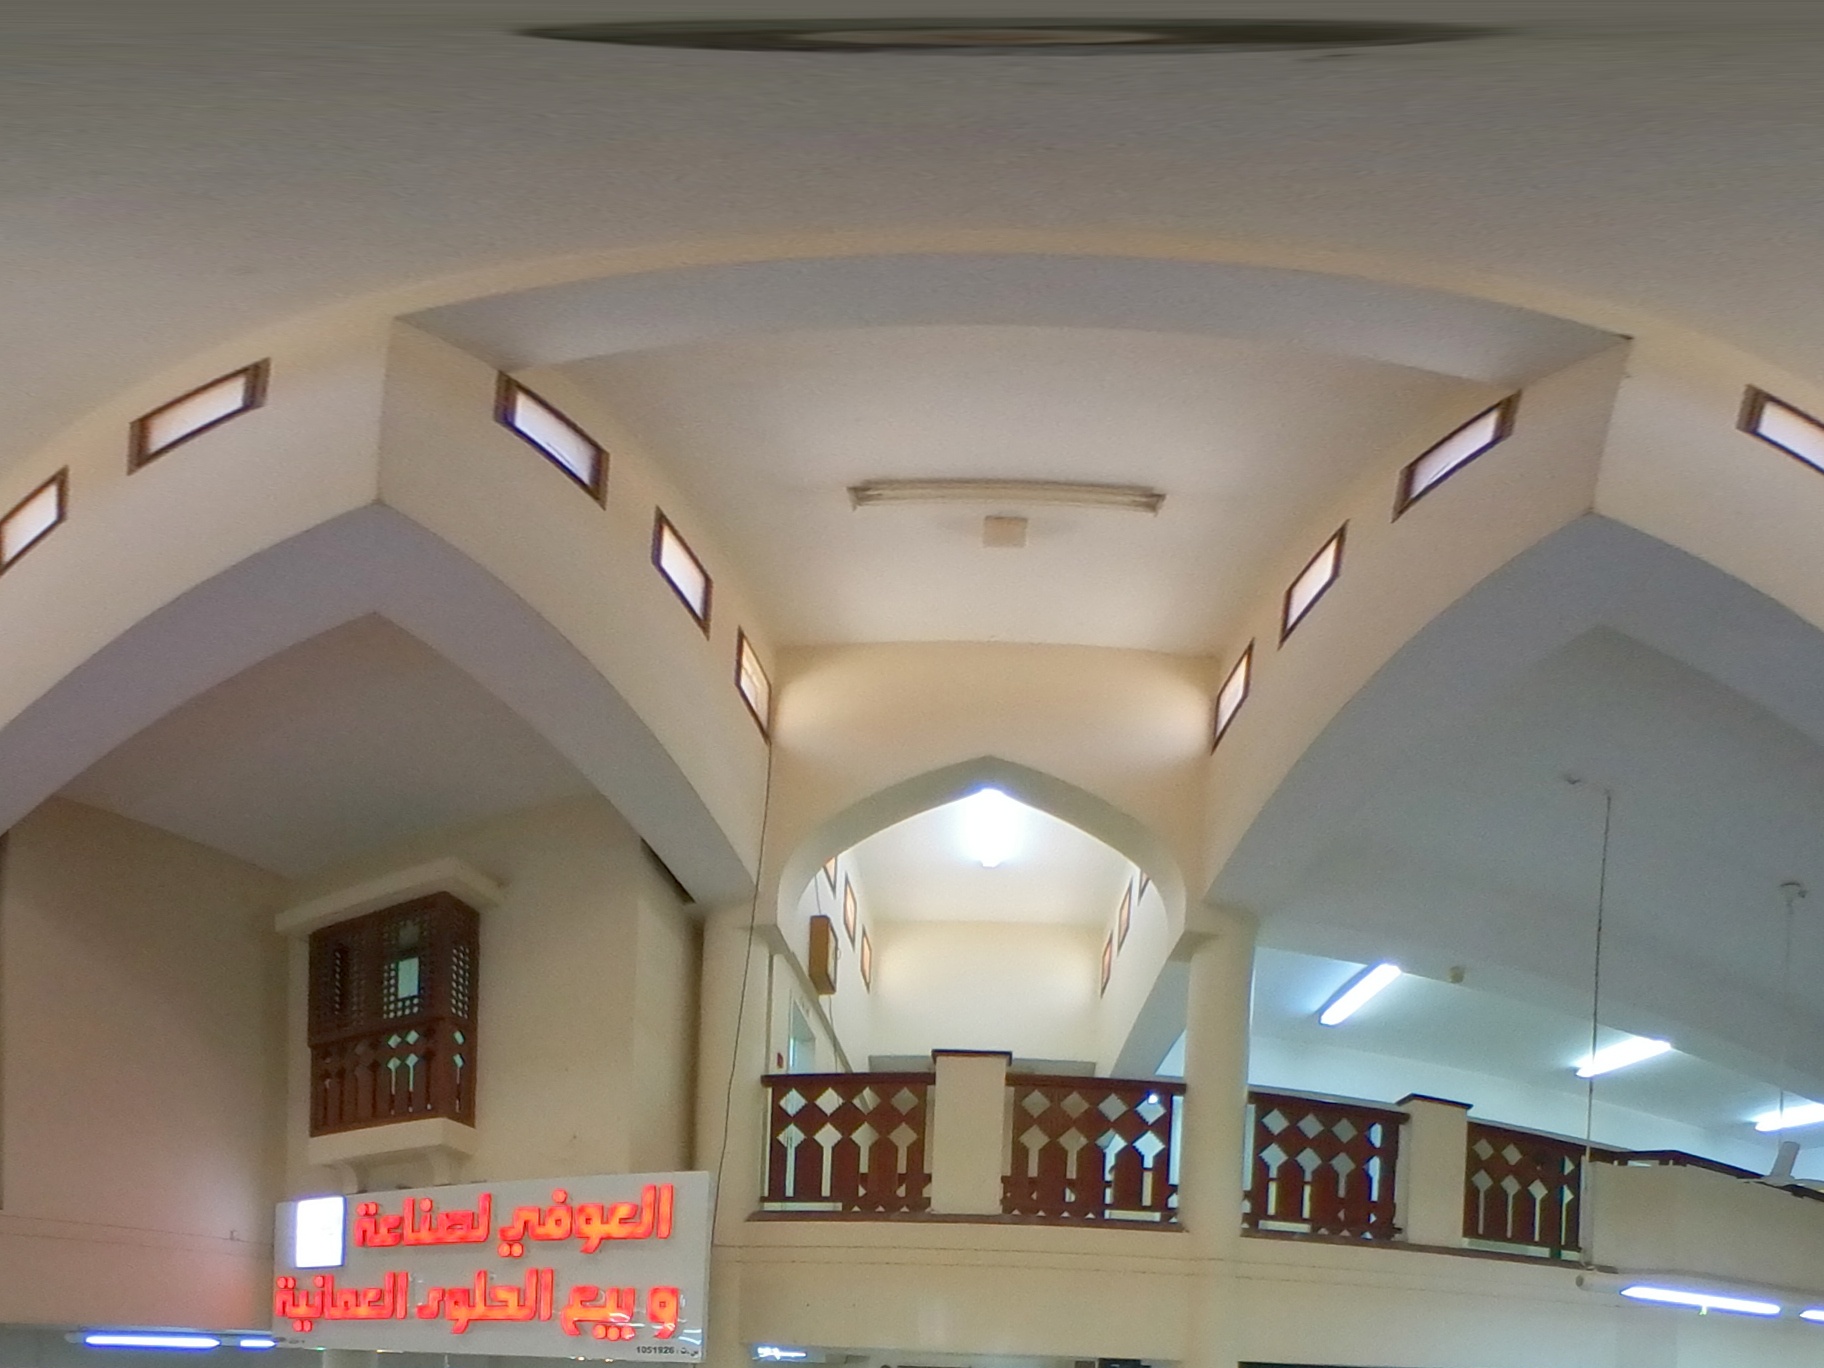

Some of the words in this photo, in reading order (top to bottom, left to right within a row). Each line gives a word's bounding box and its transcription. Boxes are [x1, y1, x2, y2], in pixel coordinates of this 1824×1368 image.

[353, 1192, 493, 1248] لصناعة
[498, 1183, 675, 1259] العوفي
[274, 1270, 410, 1333] العمانية
[415, 1266, 555, 1335] الحلوى
[560, 1284, 637, 1341] بيع
